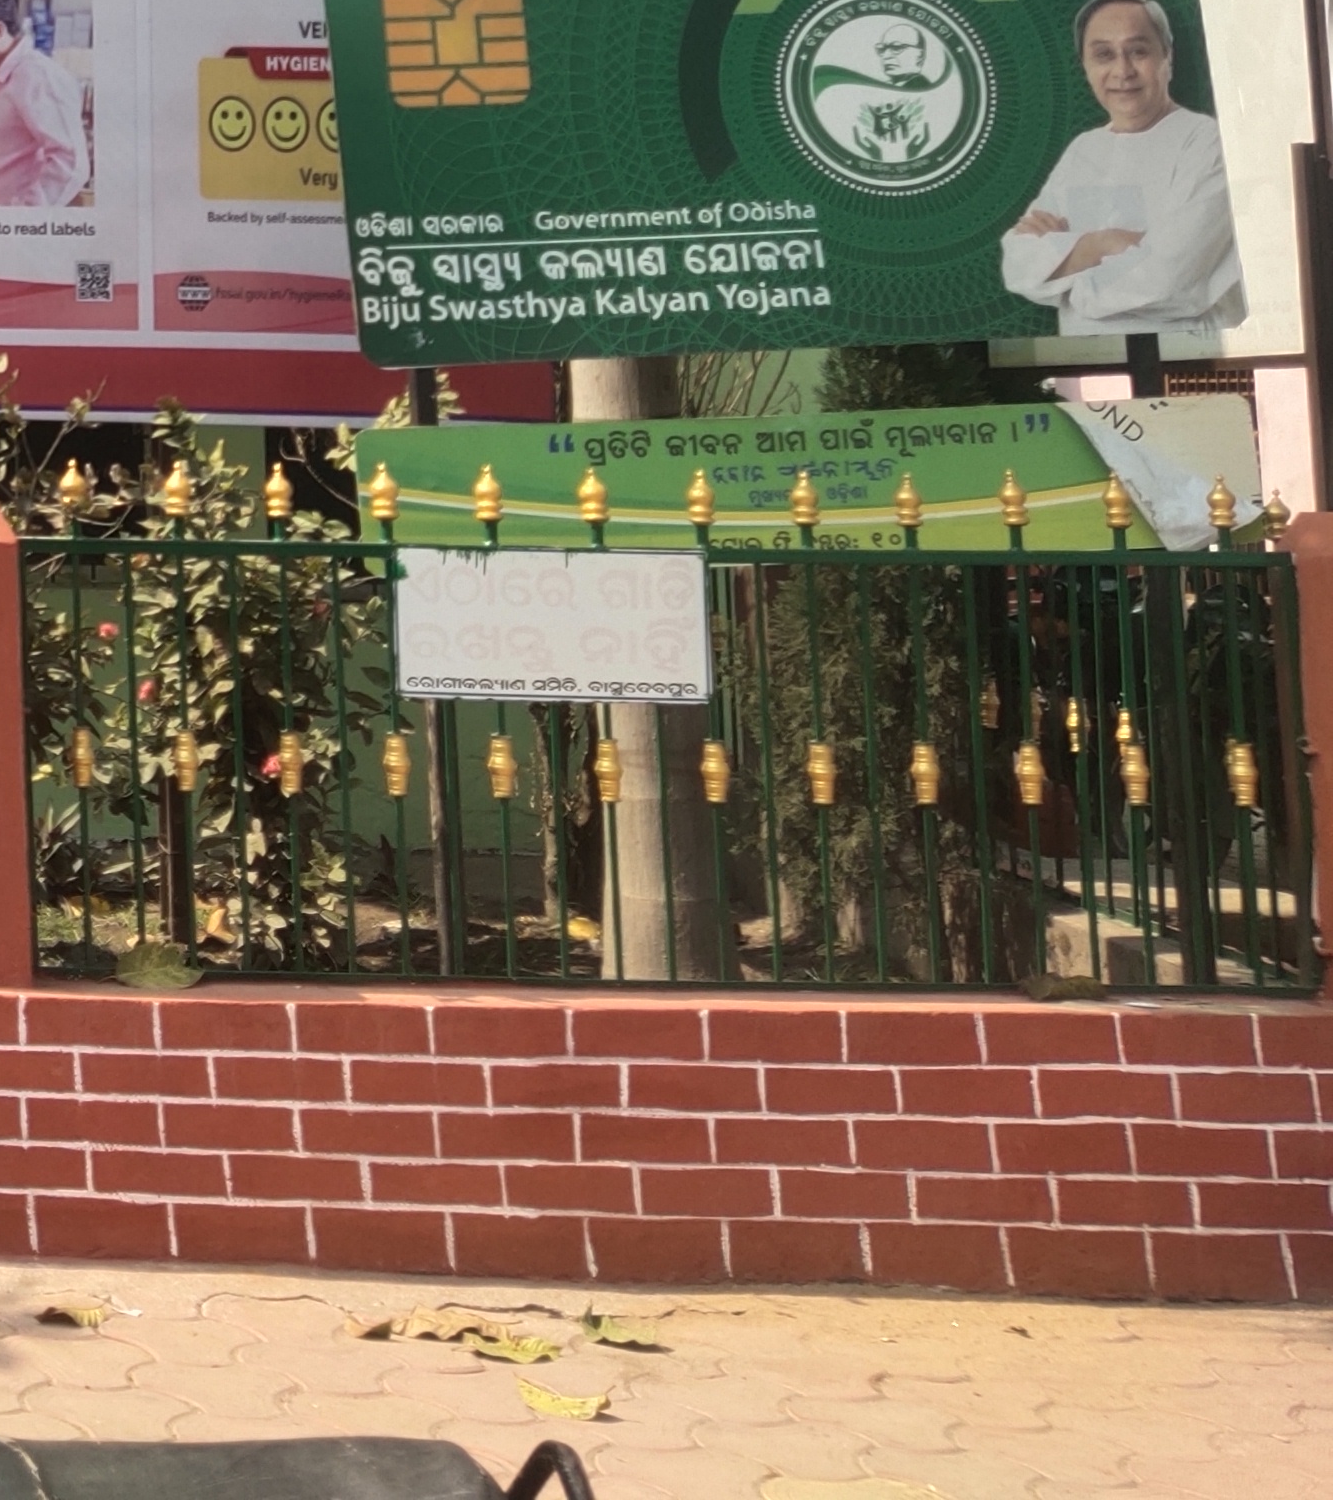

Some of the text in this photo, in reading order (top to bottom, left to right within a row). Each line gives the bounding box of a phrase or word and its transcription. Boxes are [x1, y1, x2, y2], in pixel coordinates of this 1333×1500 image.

[534, 200, 816, 232] Government of Odisha
[358, 246, 424, 298] ବିଜୁ
[539, 245, 666, 281] କଲ୍ୟାଣ
[684, 239, 825, 275] ଯୋଜନା
[363, 282, 831, 329] Biju Swasthya Kalyan Yojana
[756, 430, 809, 453] ଆମ
